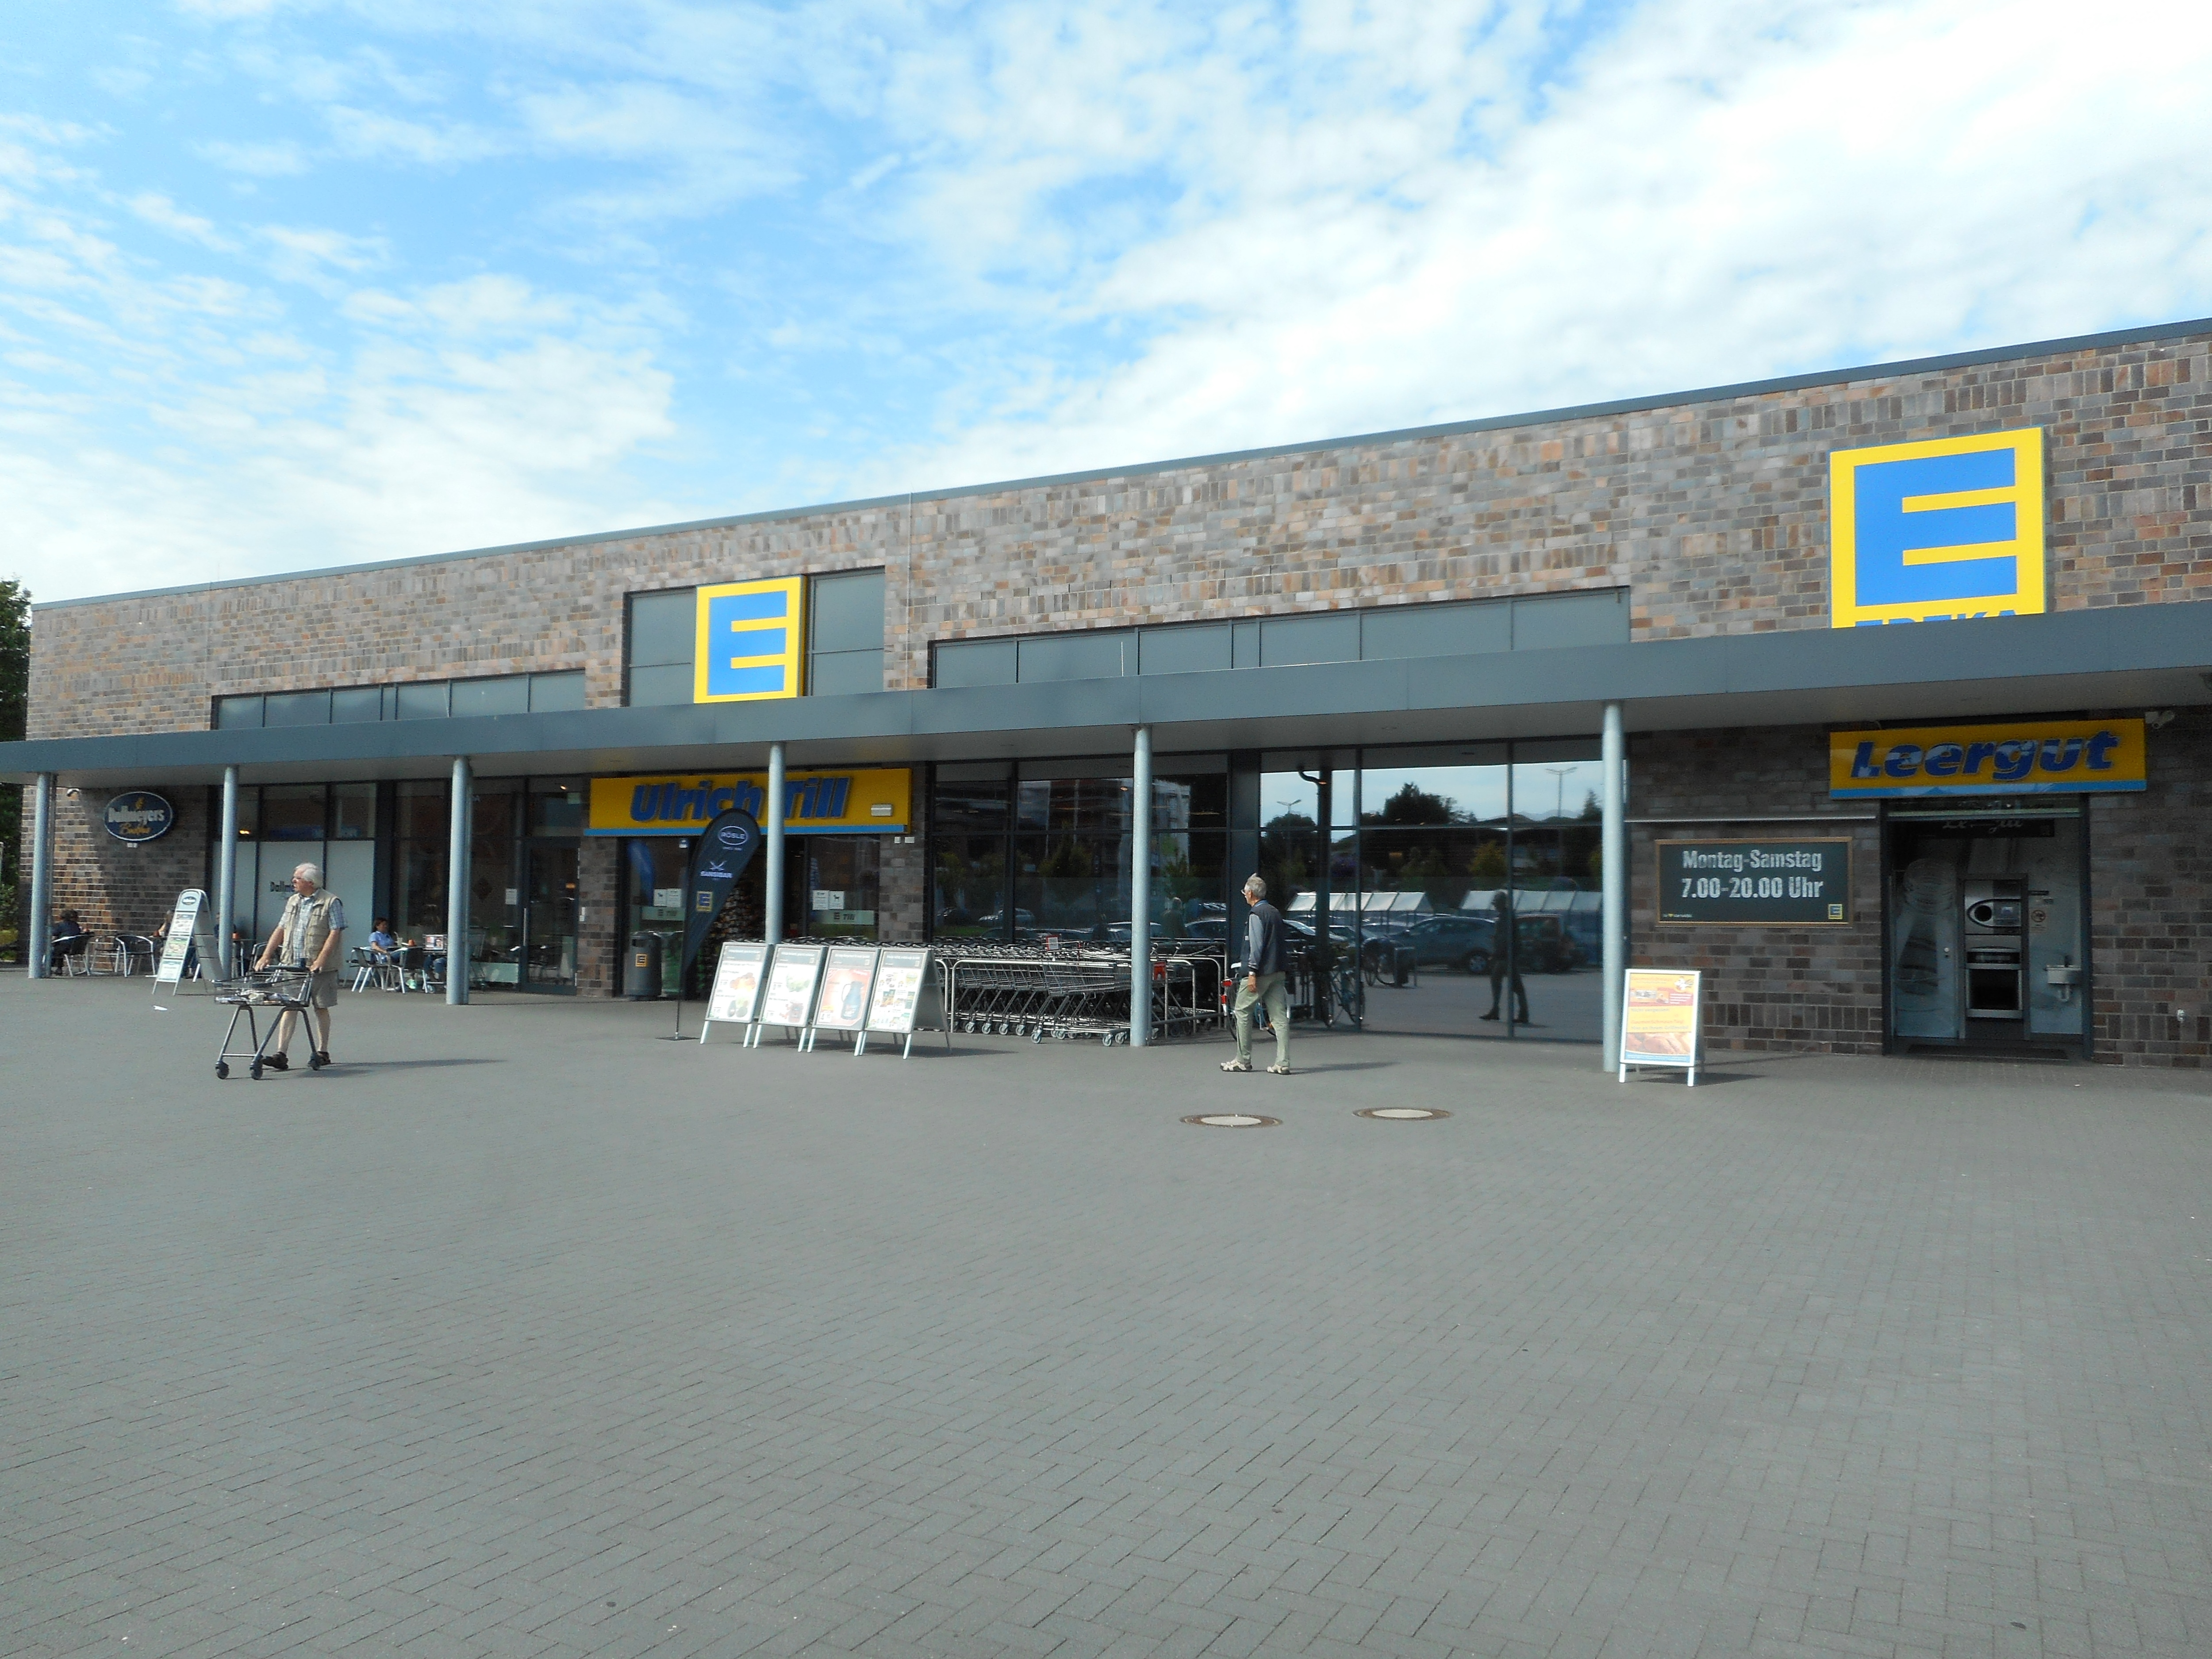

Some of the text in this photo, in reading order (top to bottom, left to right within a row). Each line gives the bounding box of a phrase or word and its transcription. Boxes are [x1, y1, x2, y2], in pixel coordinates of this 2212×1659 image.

[1854, 448, 2017, 607] E
[707, 590, 787, 696] E
[1851, 730, 2120, 780] Leergut
[630, 777, 851, 822] Ulrich Till
[1682, 849, 1822, 872] Montag-Samstag
[1682, 876, 1824, 898] 7.00-20.00 Uhr
